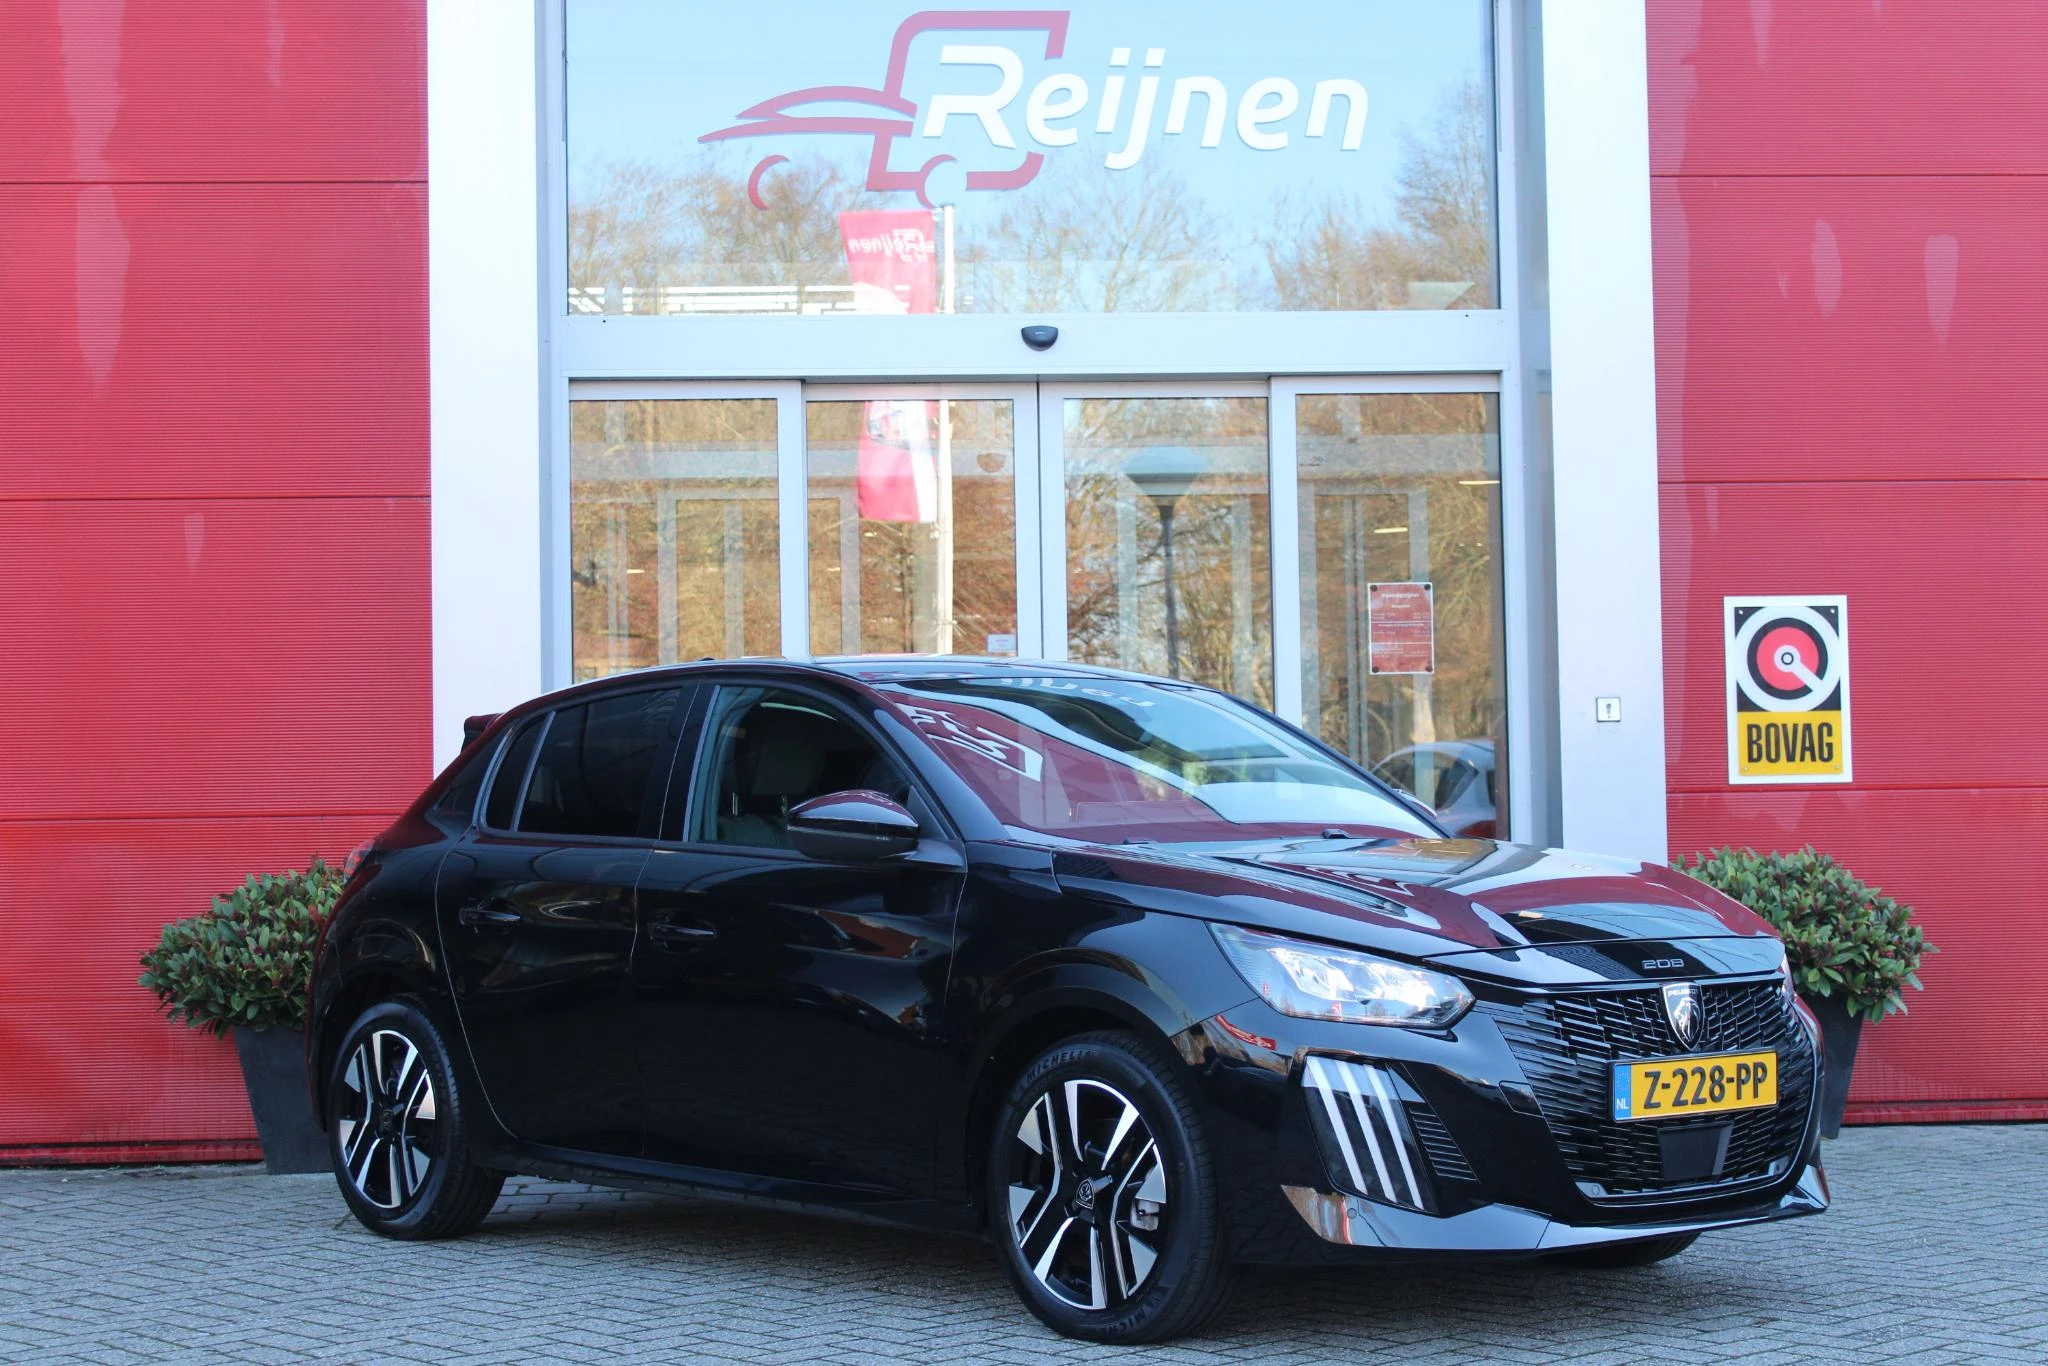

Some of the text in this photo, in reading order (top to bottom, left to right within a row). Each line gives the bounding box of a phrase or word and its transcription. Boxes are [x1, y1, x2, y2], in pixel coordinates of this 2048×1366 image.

[922, 45, 1369, 169] Reijnen
[1747, 722, 1834, 763] BOVAG
[1643, 959, 1684, 969] 208
[1616, 1098, 1629, 1110] NL
[1643, 1061, 1768, 1109] Z-228-PP
